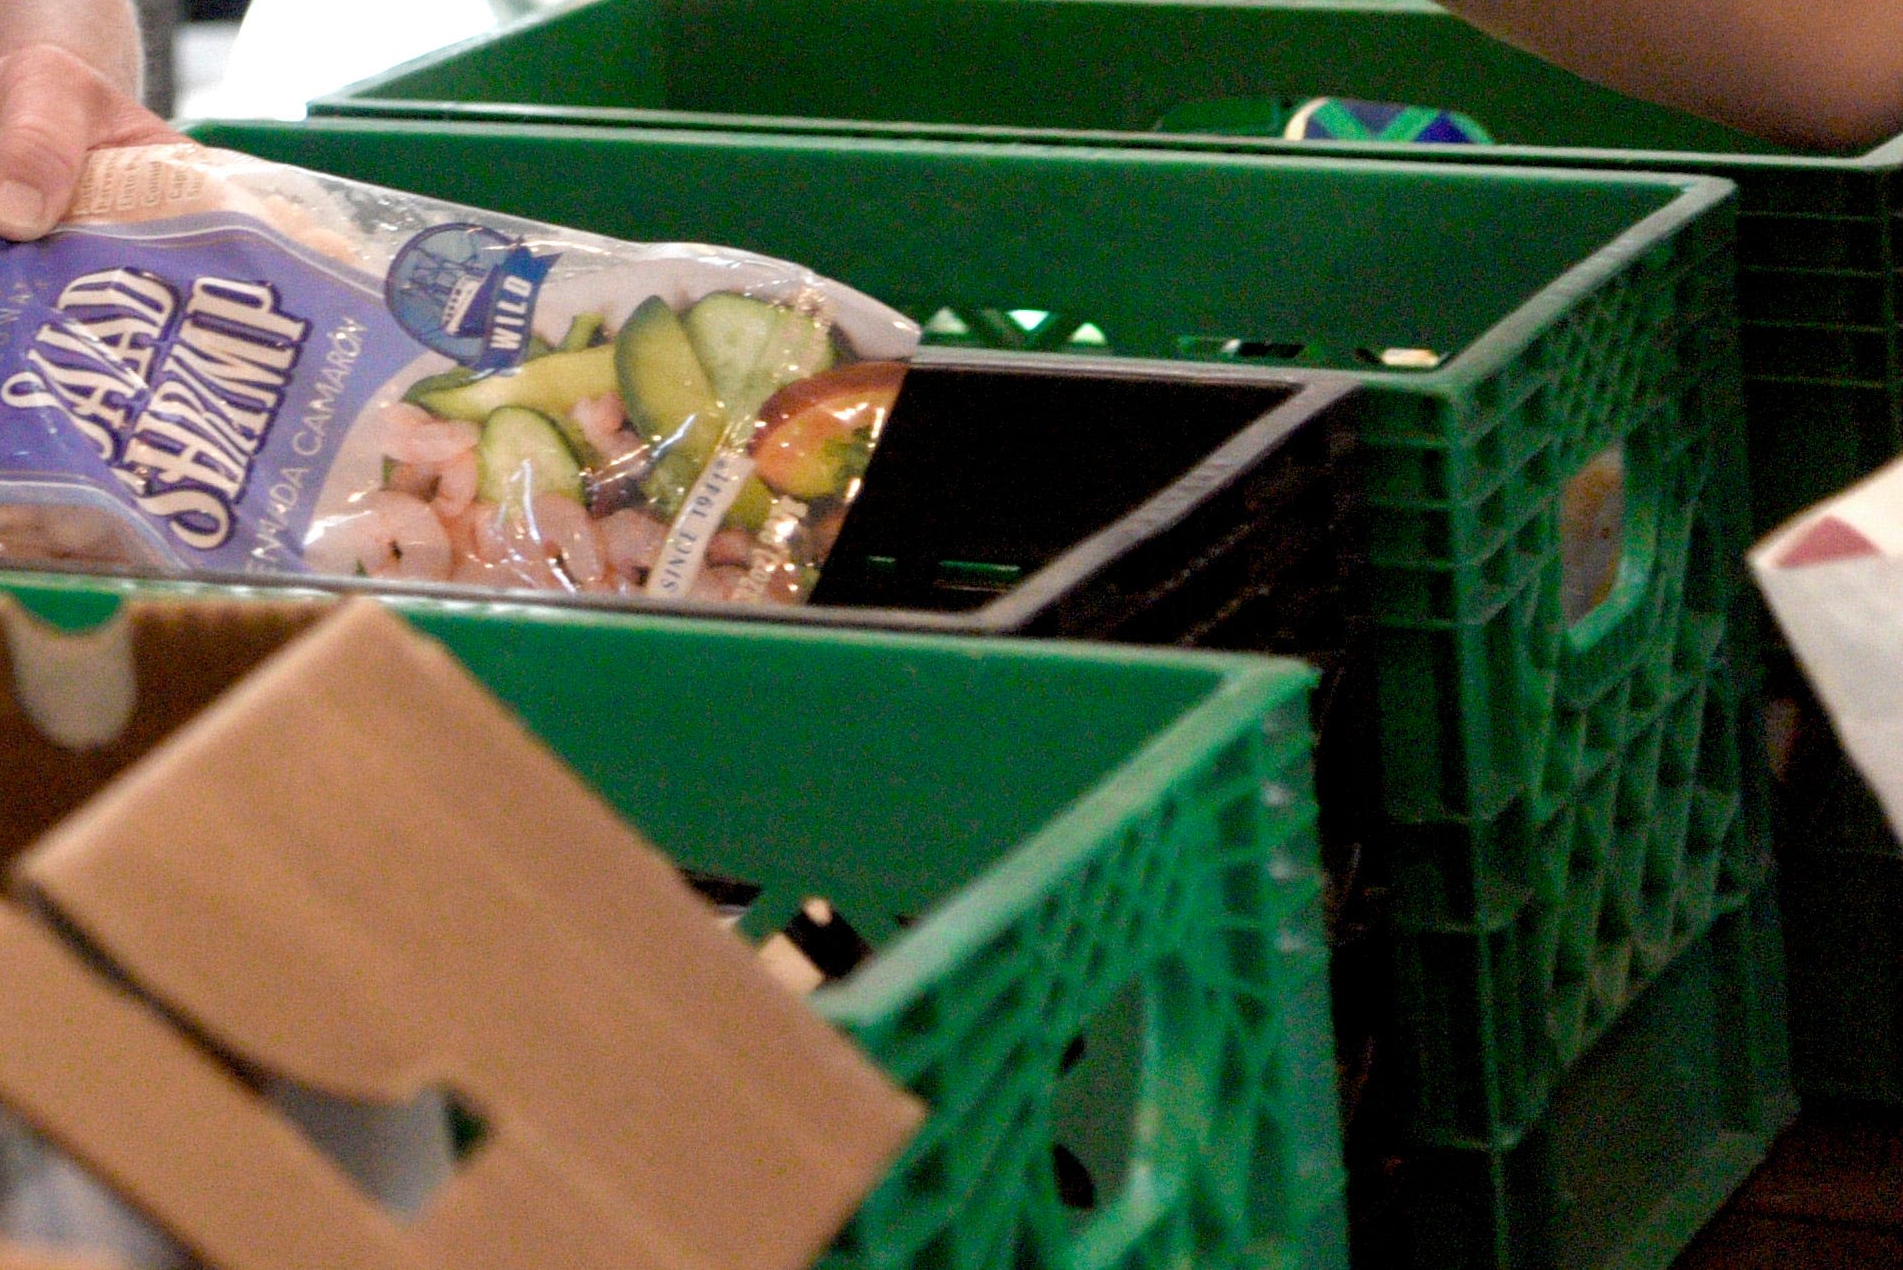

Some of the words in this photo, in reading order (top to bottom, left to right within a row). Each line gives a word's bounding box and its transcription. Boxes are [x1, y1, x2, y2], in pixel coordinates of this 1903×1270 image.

[489, 274, 533, 351] WILD
[108, 275, 311, 551] SHRIMP
[293, 316, 369, 457] CAMARÓN
[660, 531, 697, 590] SINCE
